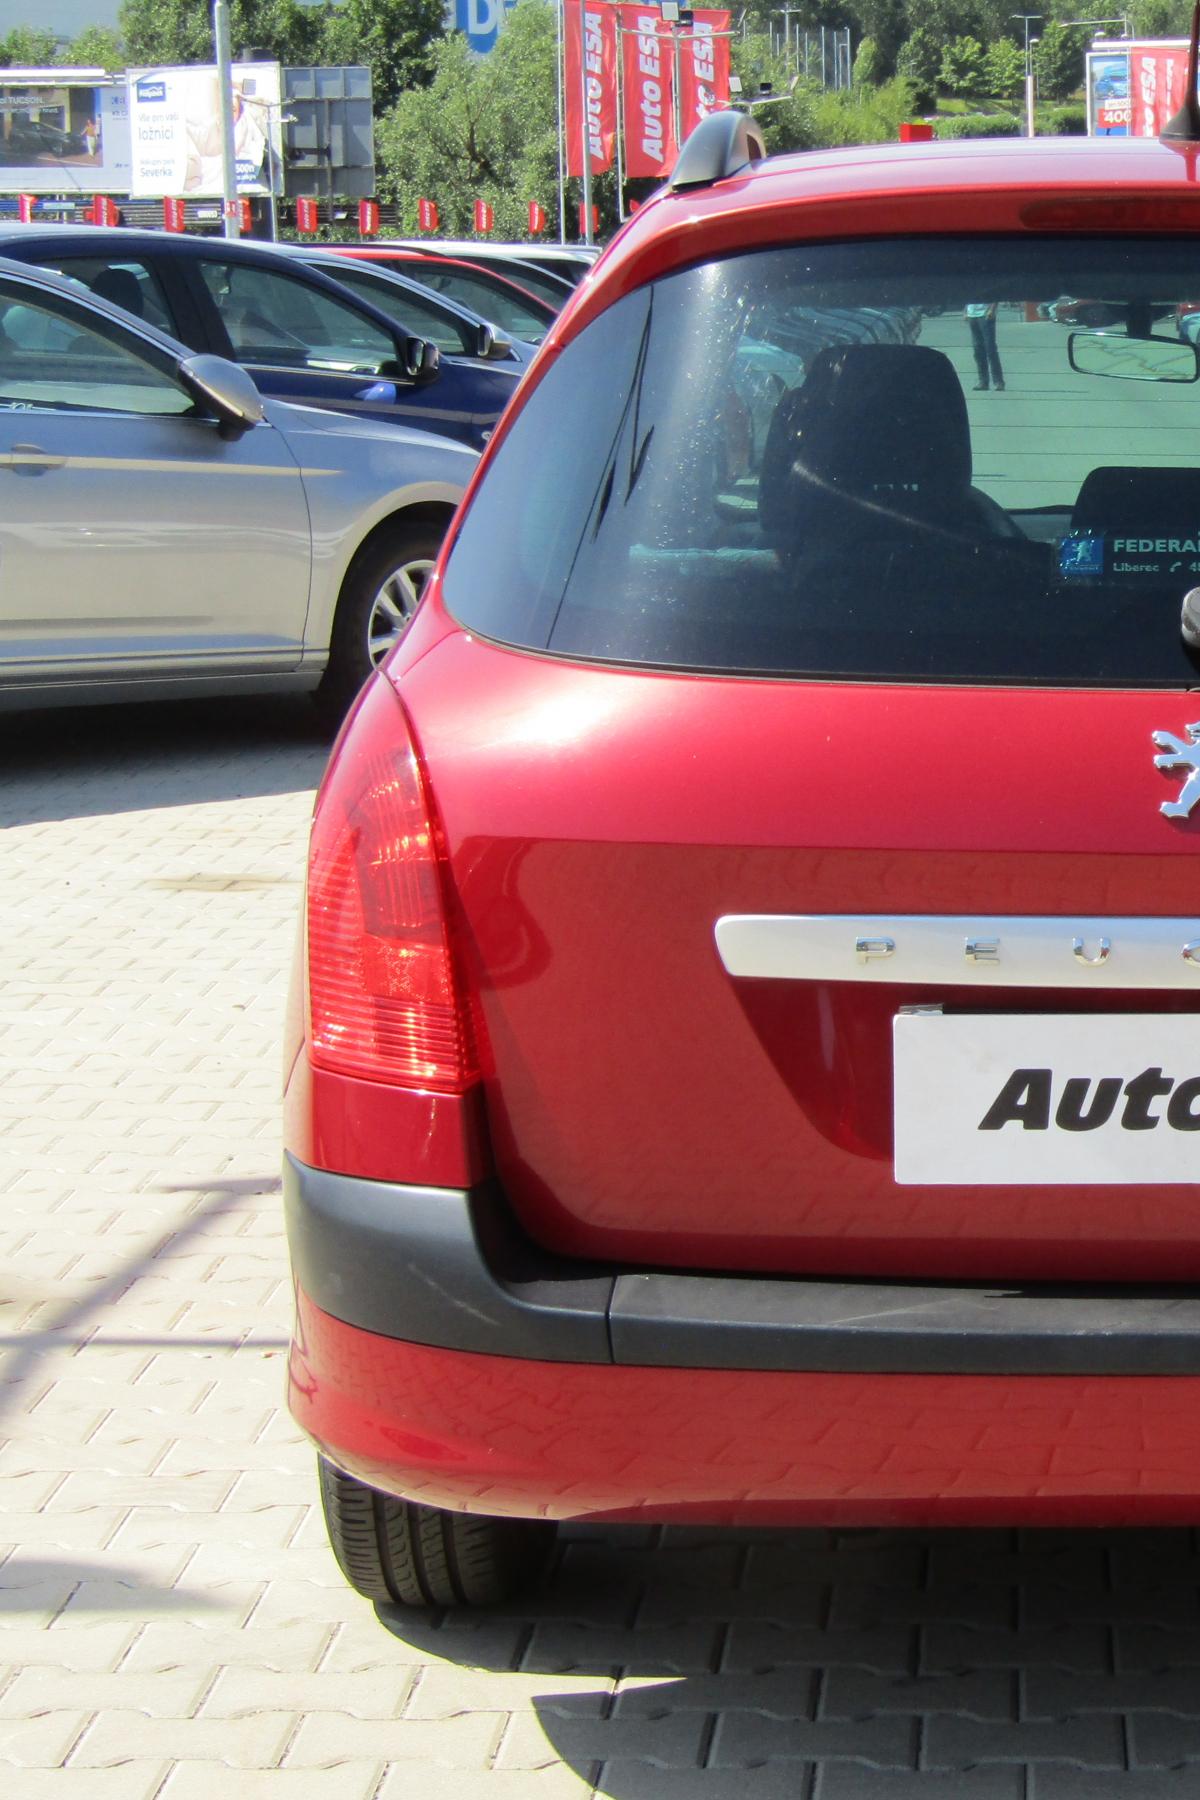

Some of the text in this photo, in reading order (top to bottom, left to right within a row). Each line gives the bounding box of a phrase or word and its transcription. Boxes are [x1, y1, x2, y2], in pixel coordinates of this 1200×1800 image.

[692, 21, 715, 83] ESA
[584, 12, 605, 161] Auto ESA
[637, 15, 665, 164] Auto ESA
[138, 126, 174, 141] ložnici
[140, 166, 173, 177] Severka
[1112, 562, 1160, 573] Liberec
